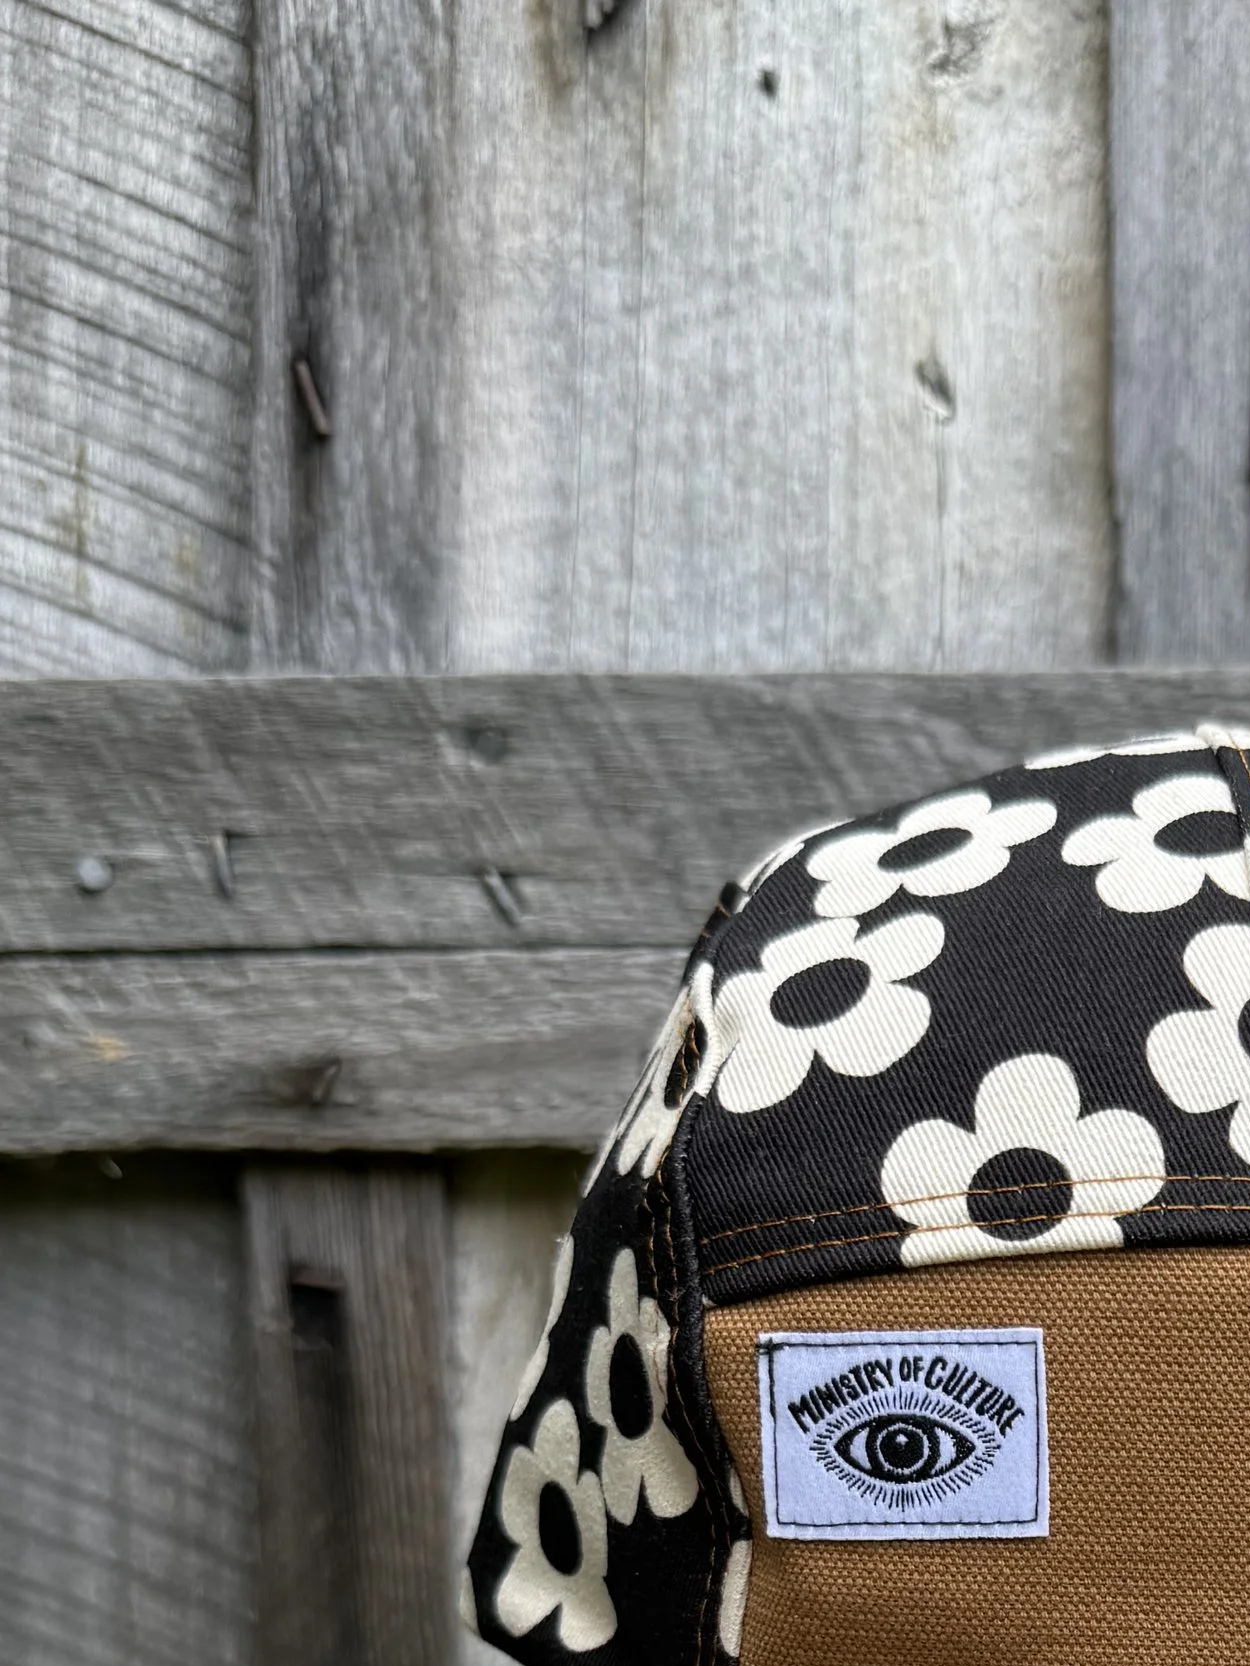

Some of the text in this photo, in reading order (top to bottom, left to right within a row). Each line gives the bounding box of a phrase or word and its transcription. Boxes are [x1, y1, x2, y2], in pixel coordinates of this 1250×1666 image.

[788, 1355, 1026, 1438] MINISTRY OF CULTURE
